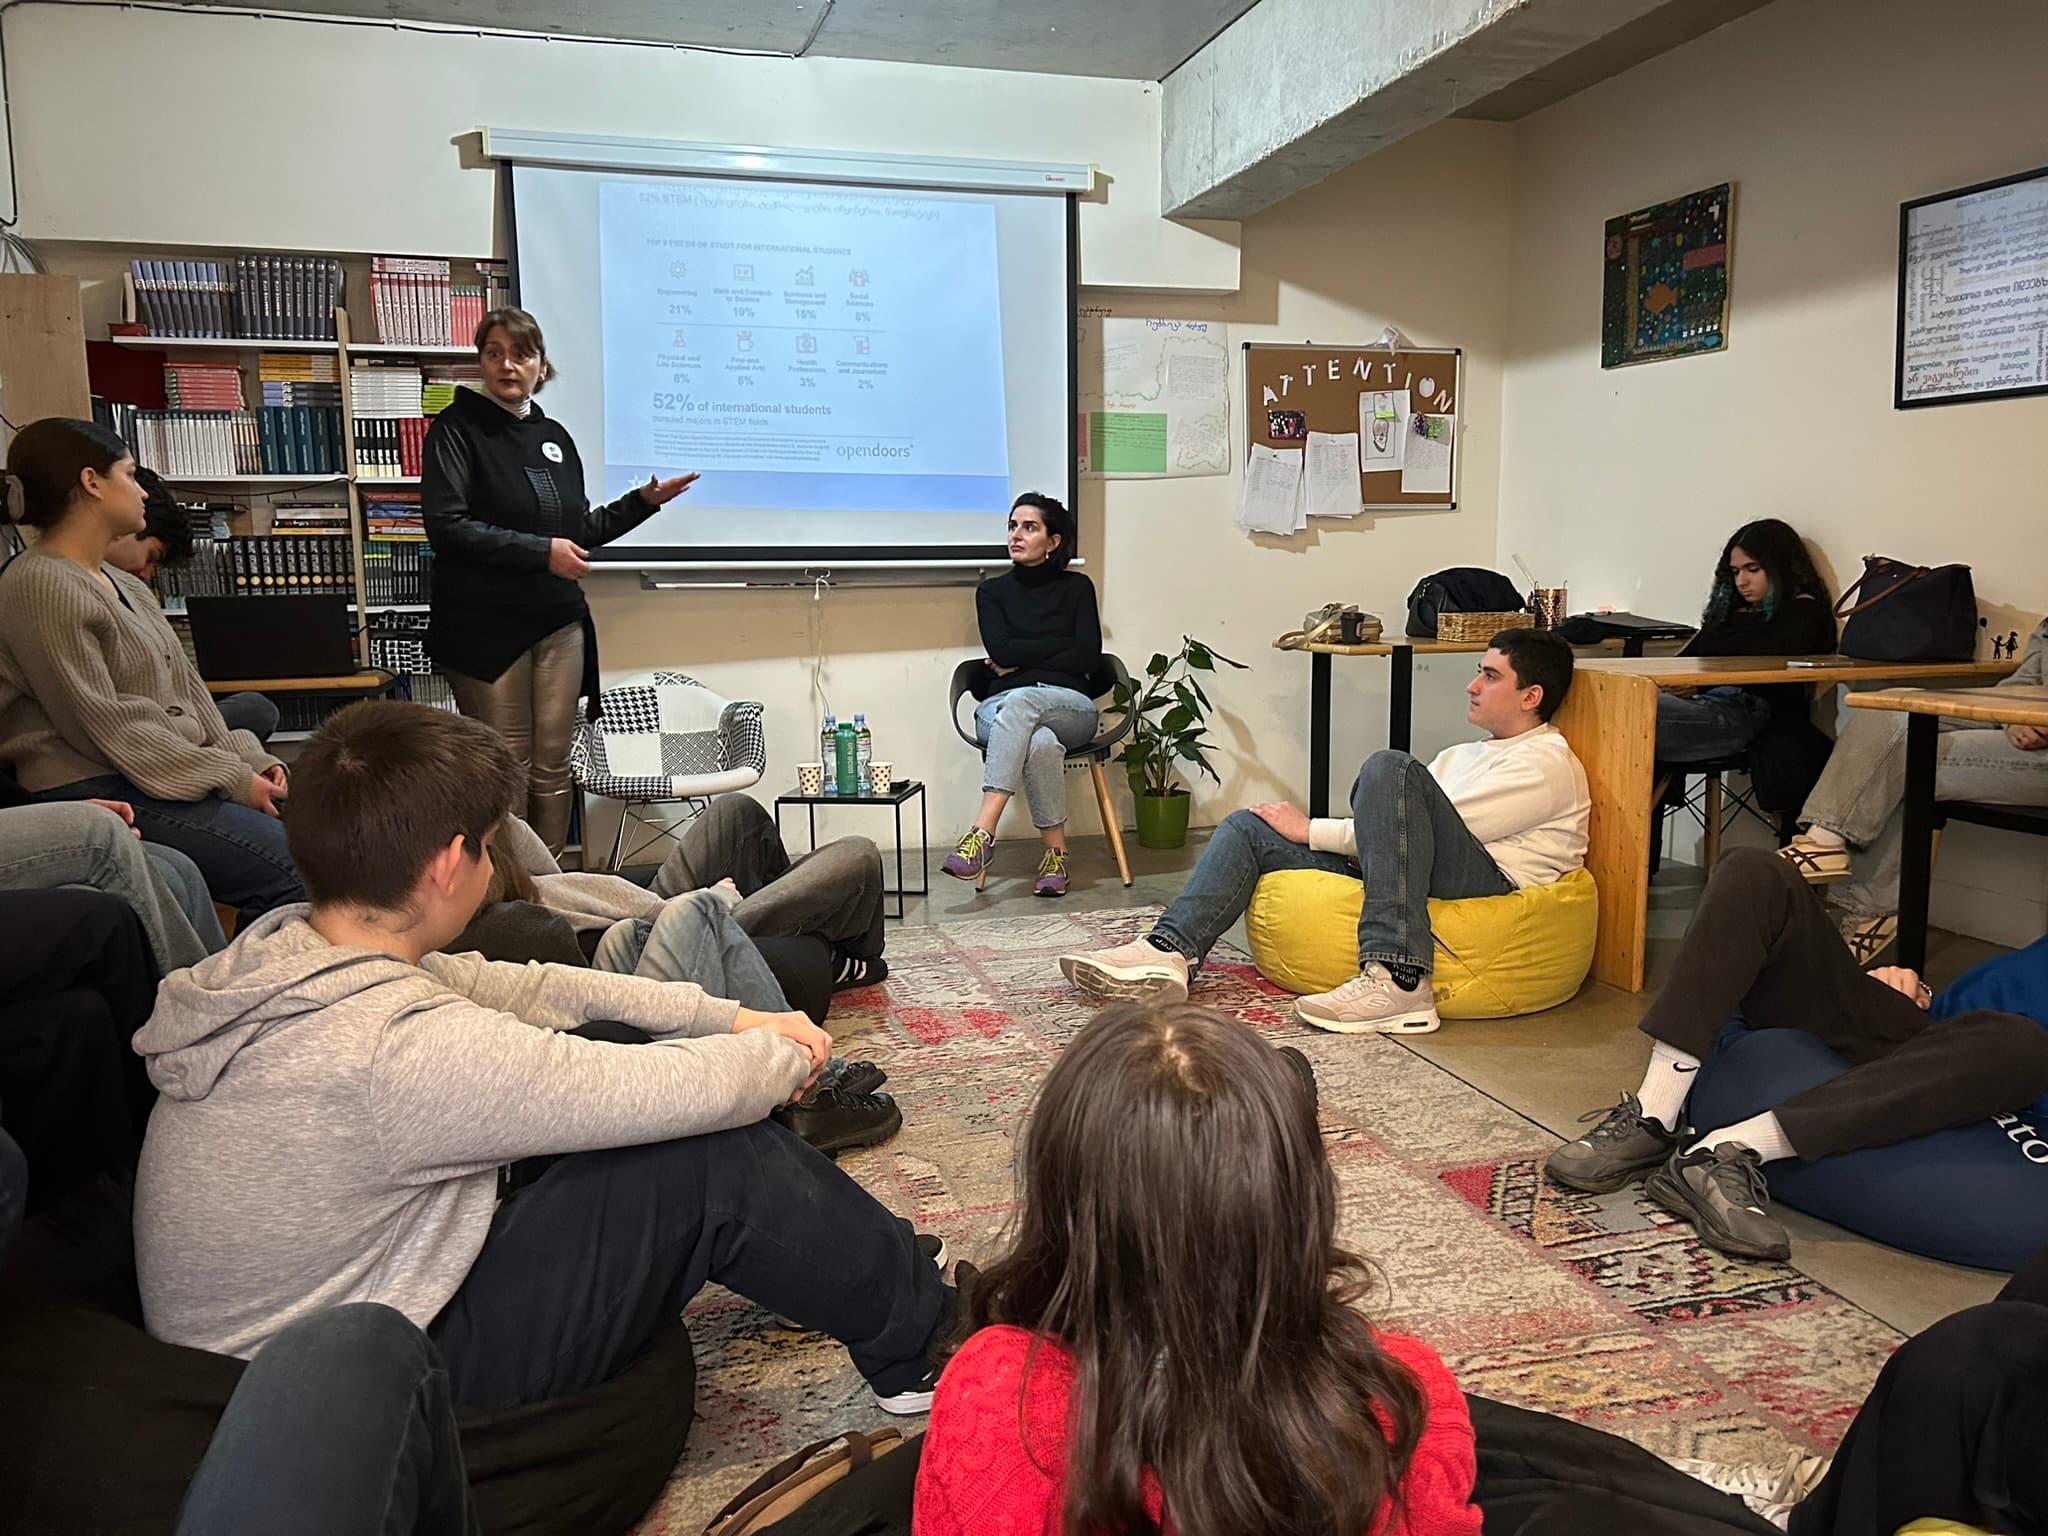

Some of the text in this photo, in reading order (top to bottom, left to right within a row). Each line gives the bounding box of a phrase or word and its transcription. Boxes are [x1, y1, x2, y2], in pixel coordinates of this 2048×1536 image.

[646, 239, 662, 248] TOP
[669, 240, 696, 249] FIELDS
[697, 241, 708, 249] OF
[711, 242, 735, 250] STUDY
[736, 243, 753, 251] FOR
[754, 243, 812, 254] INTERNATIONAL
[813, 247, 852, 256] STUDENTS
[669, 304, 692, 315] 21%
[673, 373, 691, 384] 8%
[1922, 366, 1979, 385] ვაგვიანებთ
[799, 376, 816, 388] 3%
[857, 378, 874, 390] 2%
[1262, 356, 1454, 414] ATTENTION
[652, 392, 832, 416] 52% of international students
[652, 415, 684, 425] pursued
[686, 417, 712, 427] majors
[722, 417, 747, 427] STEM
[748, 418, 769, 427] fields
